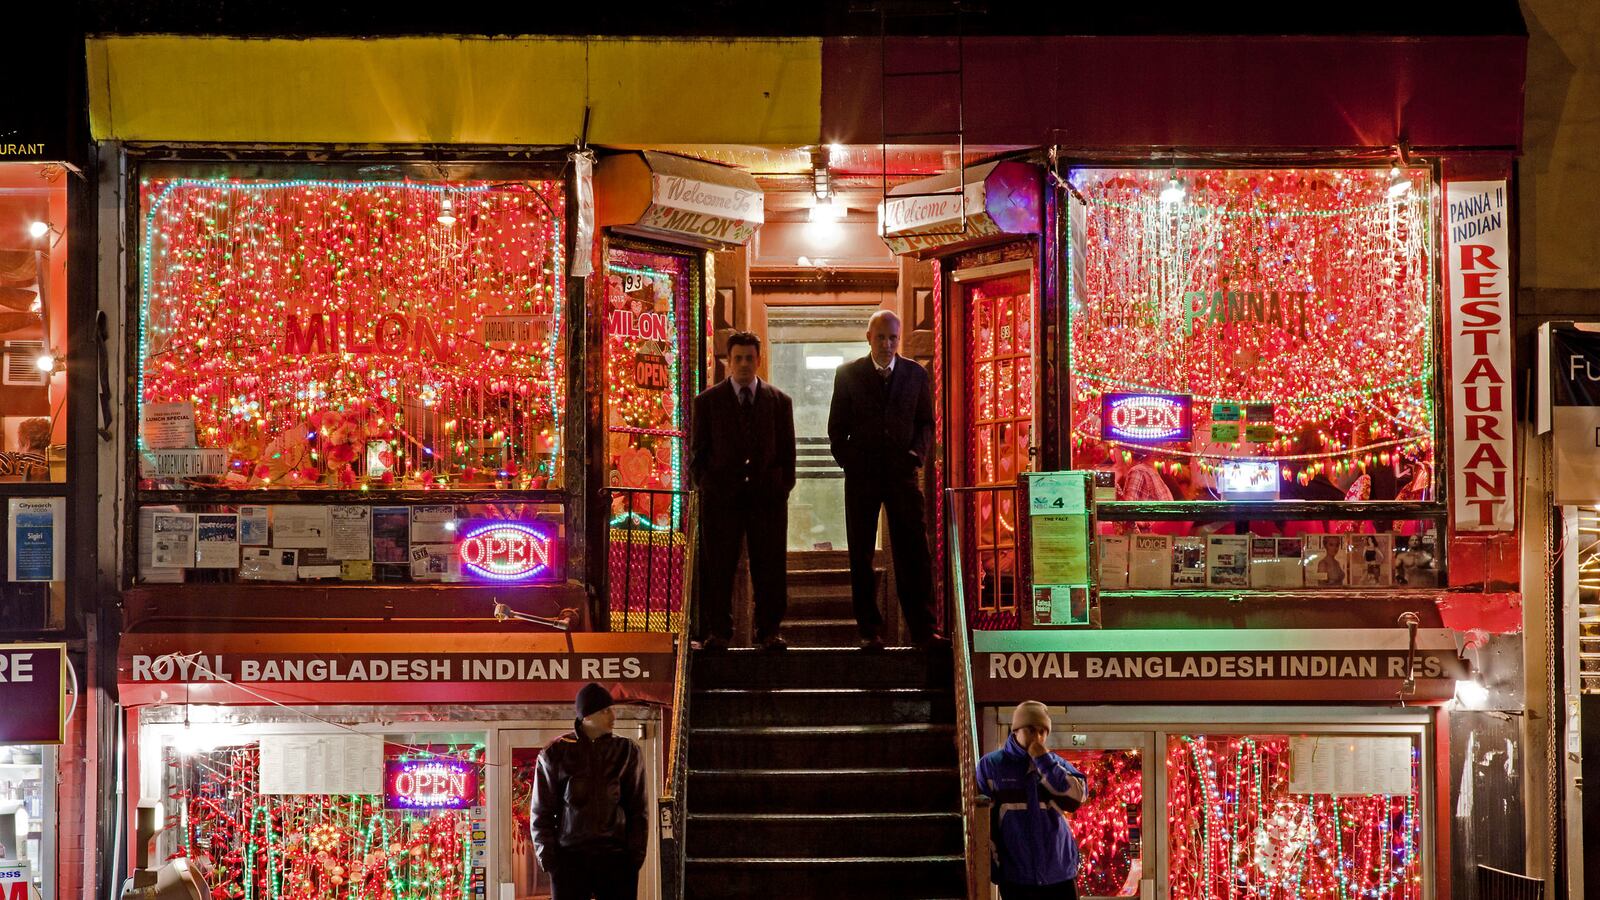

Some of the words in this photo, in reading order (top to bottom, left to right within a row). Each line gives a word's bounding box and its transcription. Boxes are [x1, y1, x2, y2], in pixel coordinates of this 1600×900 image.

[666, 177, 731, 209] Welcome
[733, 189, 753, 213] To
[1450, 191, 1491, 224] PANNA
[1496, 187, 1503, 208] II
[662, 210, 735, 238] MILON
[888, 199, 948, 226] Welcome
[1453, 211, 1502, 243] INDIAN
[626, 274, 642, 291] 93
[608, 309, 670, 341] MILON
[1184, 289, 1283, 336] PANNA
[284, 312, 449, 364] MILON
[636, 362, 668, 387] OPEN
[1459, 244, 1507, 526] RESTAURANT
[1111, 405, 1183, 428] OPEN
[1052, 497, 1064, 508] 4
[461, 537, 551, 567] OPEN
[1138, 538, 1166, 549] VOICE
[132, 654, 232, 681] ROYAL
[241, 659, 451, 681] BANGLADESH
[462, 658, 570, 680] INDIAN
[581, 657, 650, 679] RES.
[989, 653, 1079, 679] ROYAL
[1086, 656, 1274, 678] BANGLADESH
[1280, 656, 1377, 678] INDIAN
[1388, 656, 1449, 677] RES.
[396, 772, 466, 797] OPEN
